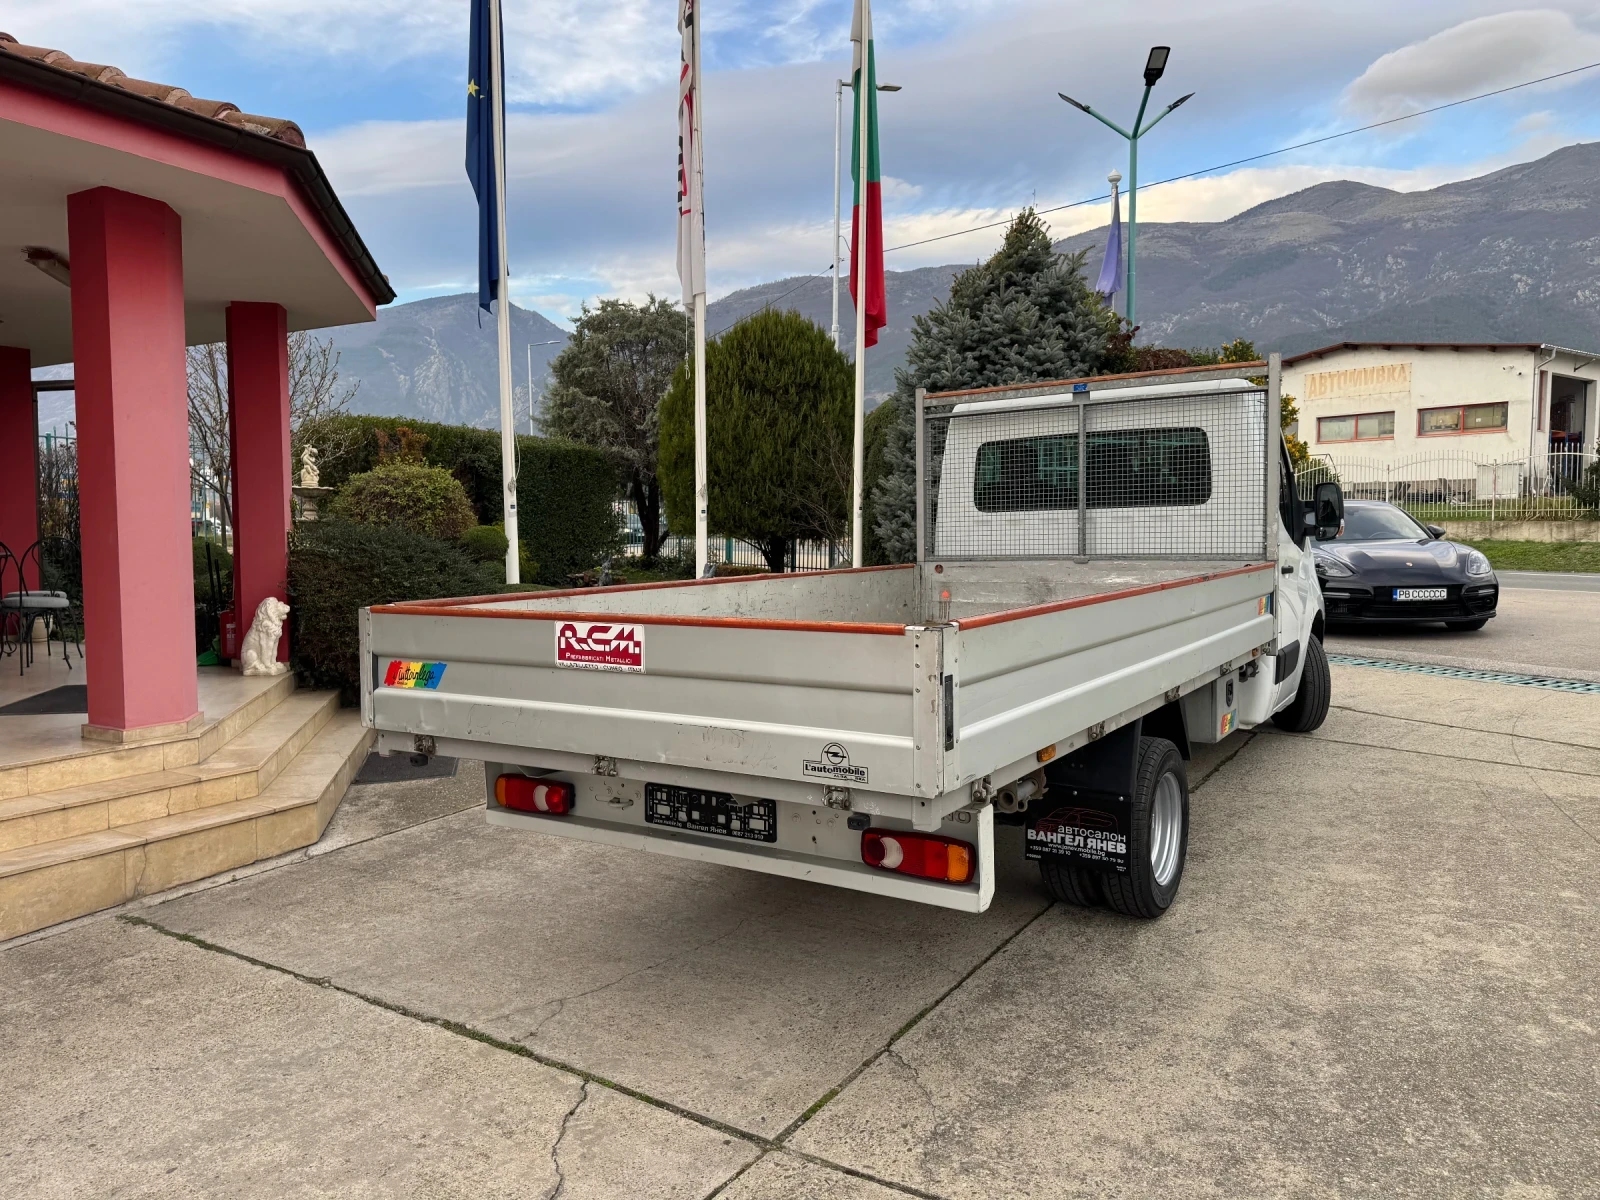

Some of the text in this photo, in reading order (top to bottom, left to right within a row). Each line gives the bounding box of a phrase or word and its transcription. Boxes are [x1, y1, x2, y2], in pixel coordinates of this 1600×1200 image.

[1308, 365, 1409, 398] АВТОМИВКА
[804, 763, 866, 776] L'automobile
[686, 822, 727, 835] Вангел Янев
[1057, 825, 1126, 843] автосалон
[1027, 828, 1127, 854] ВАНГЕЛ ЯНЕВ
